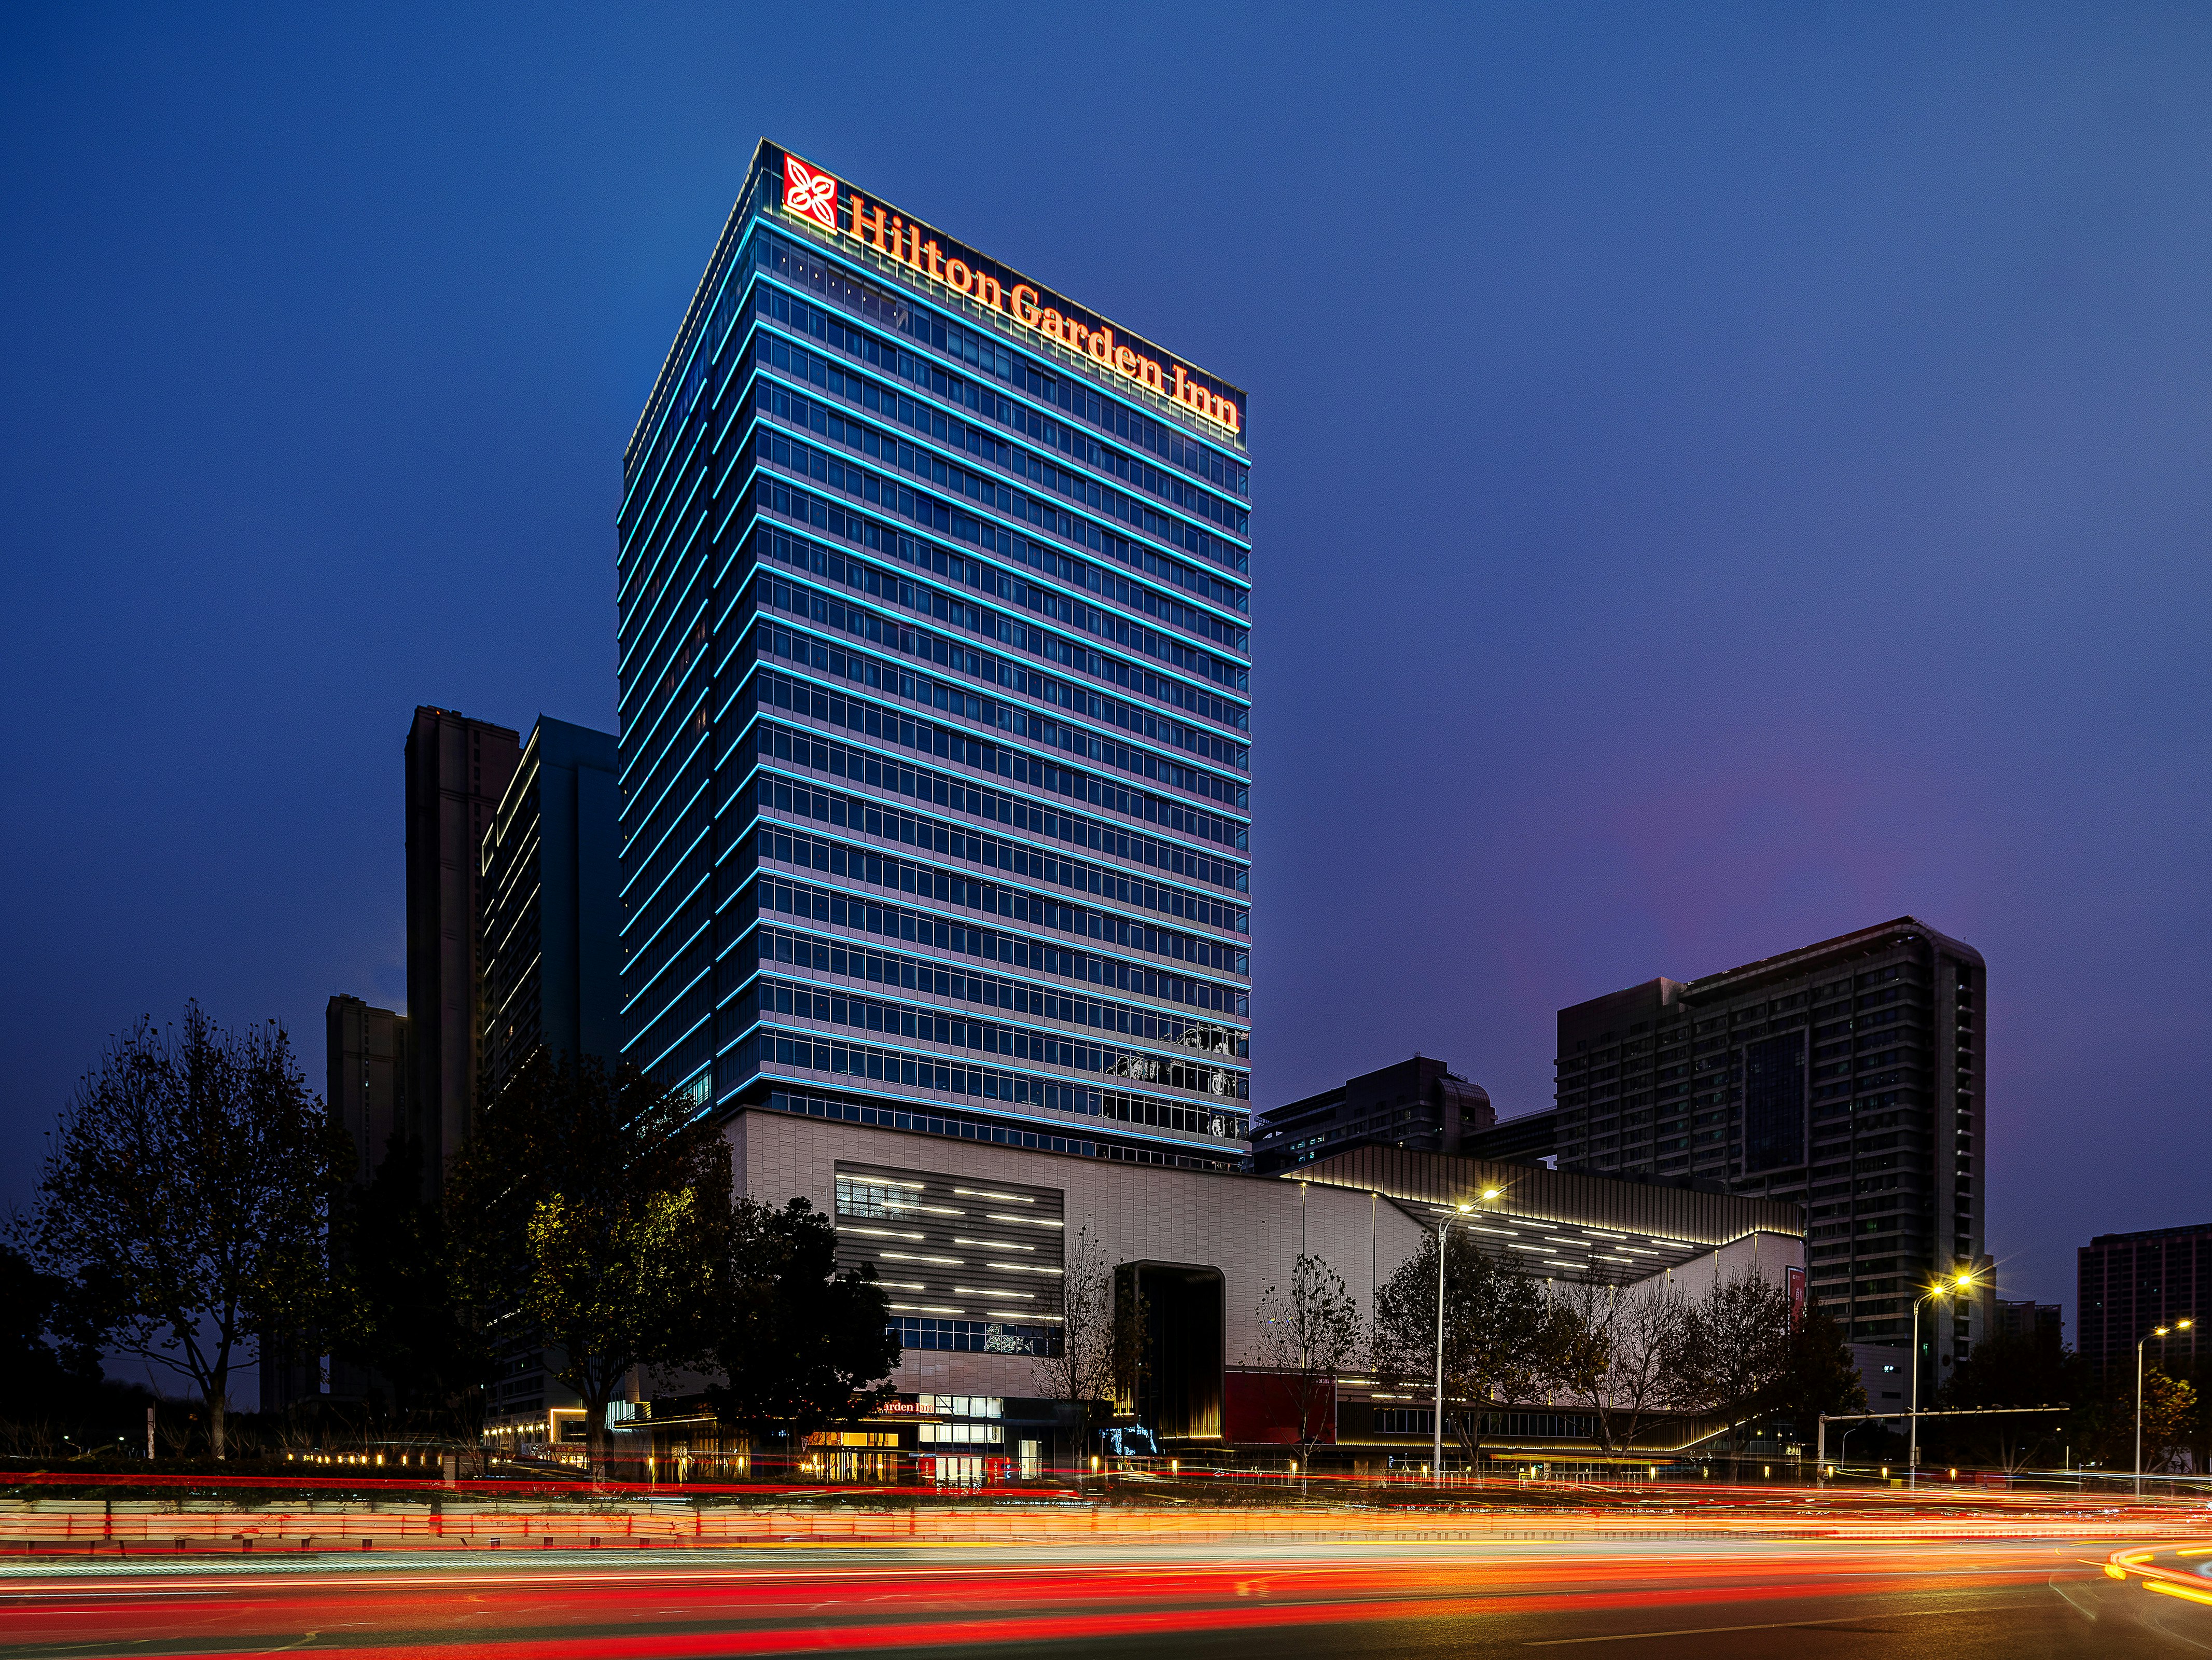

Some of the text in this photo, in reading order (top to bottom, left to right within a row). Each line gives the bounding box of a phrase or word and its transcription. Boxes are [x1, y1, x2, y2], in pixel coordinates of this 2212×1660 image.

[850, 193, 1240, 434] Hilton Garden Inn
[883, 1402, 933, 1413] arden Inn
